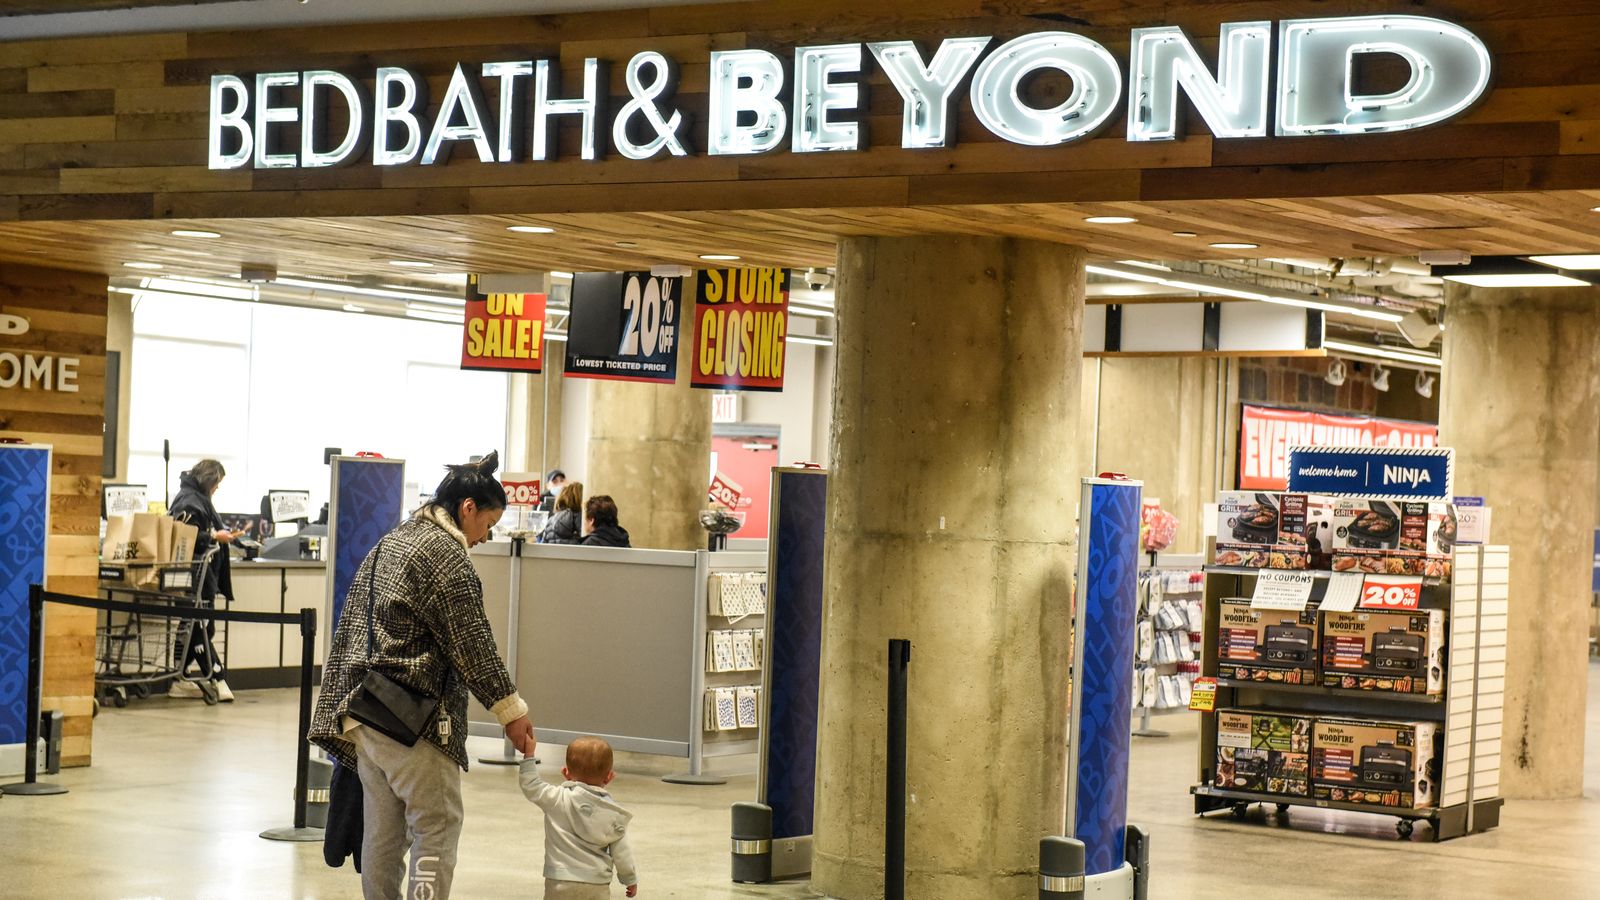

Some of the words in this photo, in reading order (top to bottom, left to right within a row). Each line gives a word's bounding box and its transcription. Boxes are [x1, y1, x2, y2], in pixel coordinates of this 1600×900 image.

[207, 70, 365, 170] BED
[373, 57, 598, 166] BATH
[611, 51, 688, 160] &
[707, 14, 1492, 156] BEYOND
[467, 317, 542, 359] SALE!
[659, 325, 674, 353] OFF
[700, 308, 785, 378] CLOSING
[576, 359, 604, 368] LOWEST
[606, 361, 641, 370] TICKETED
[643, 364, 667, 372] PRICE
[1299, 465, 1333, 477] welcome
[1334, 465, 1358, 478] home
[1383, 464, 1431, 489] NINJA
[1260, 573, 1272, 581] NO
[1274, 574, 1312, 583] COUPONS
[1403, 598, 1416, 606] OFF
[1224, 614, 1258, 623] WOODFIRE
[1328, 621, 1366, 631] WOODFIRE
[1318, 733, 1354, 744] WOODFIRE
